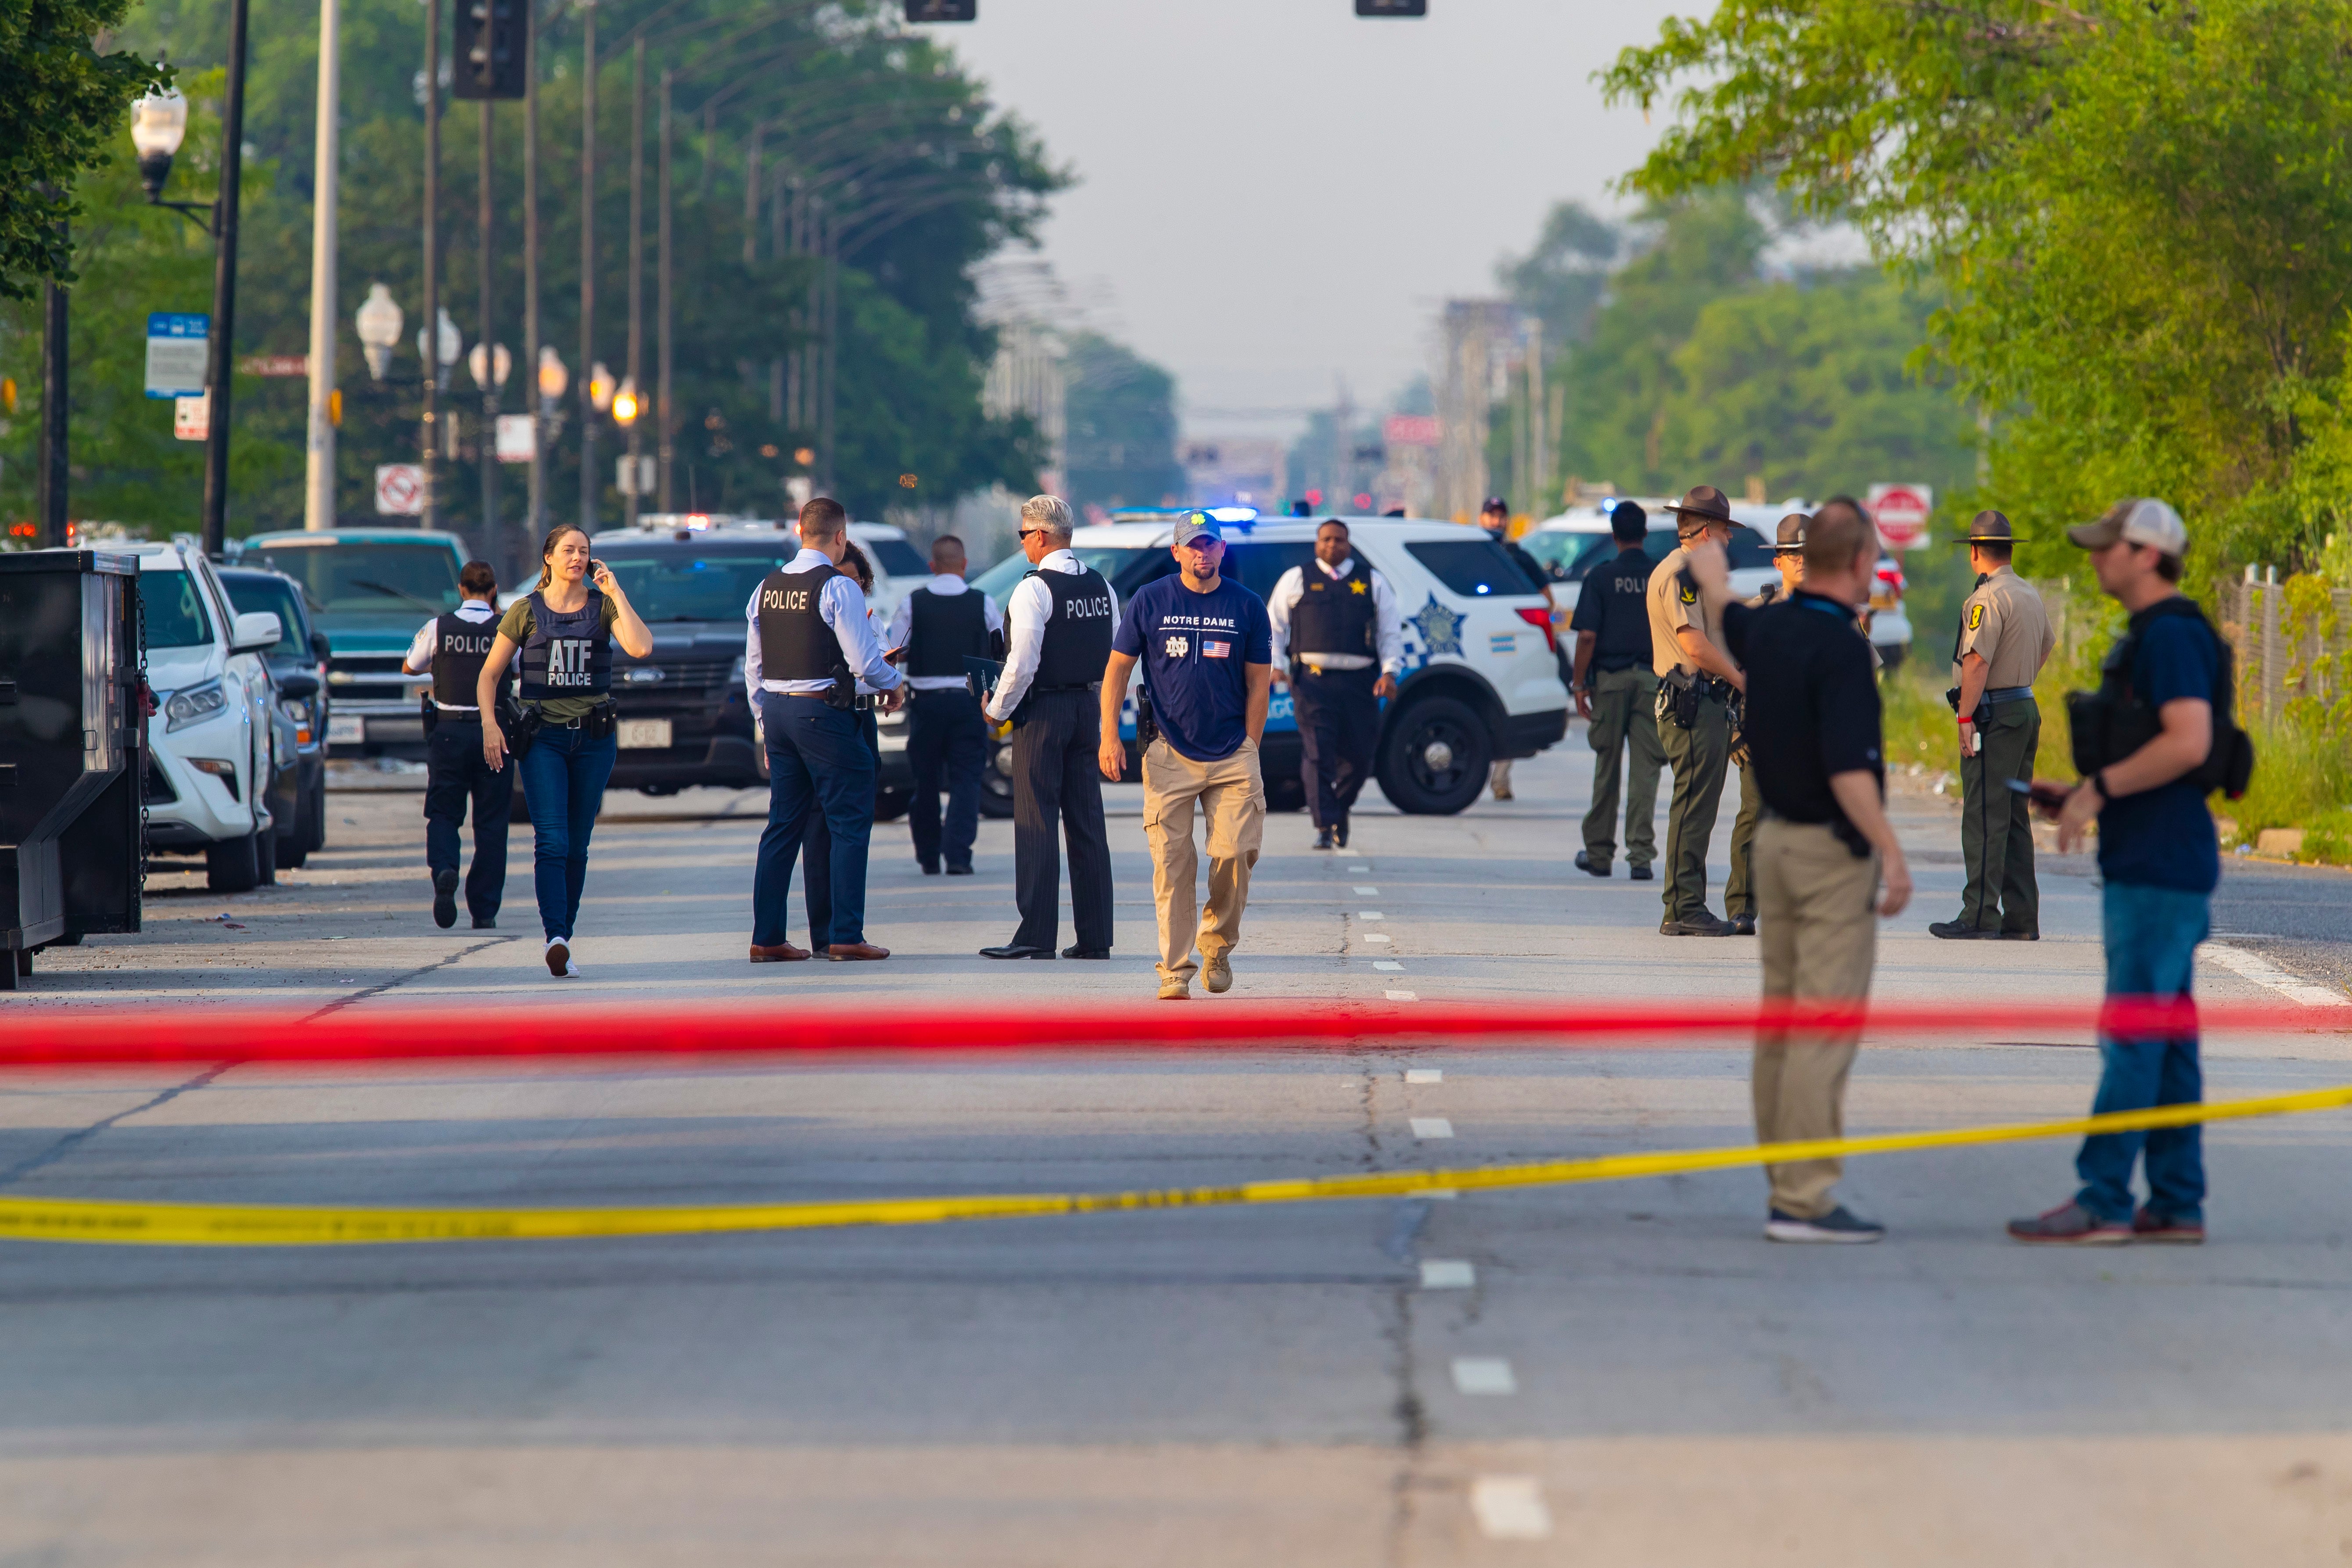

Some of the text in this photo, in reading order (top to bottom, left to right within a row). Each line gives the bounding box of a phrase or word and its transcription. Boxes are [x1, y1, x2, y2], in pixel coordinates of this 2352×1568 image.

[1615, 577, 1648, 593] POLI
[763, 590, 808, 610] POLICE
[1066, 597, 1109, 619] POLICE
[1163, 616, 1234, 627] NOTRE DAME
[445, 635, 496, 654] POLIC
[548, 640, 592, 672] ATF
[548, 673, 591, 685] POLICE
